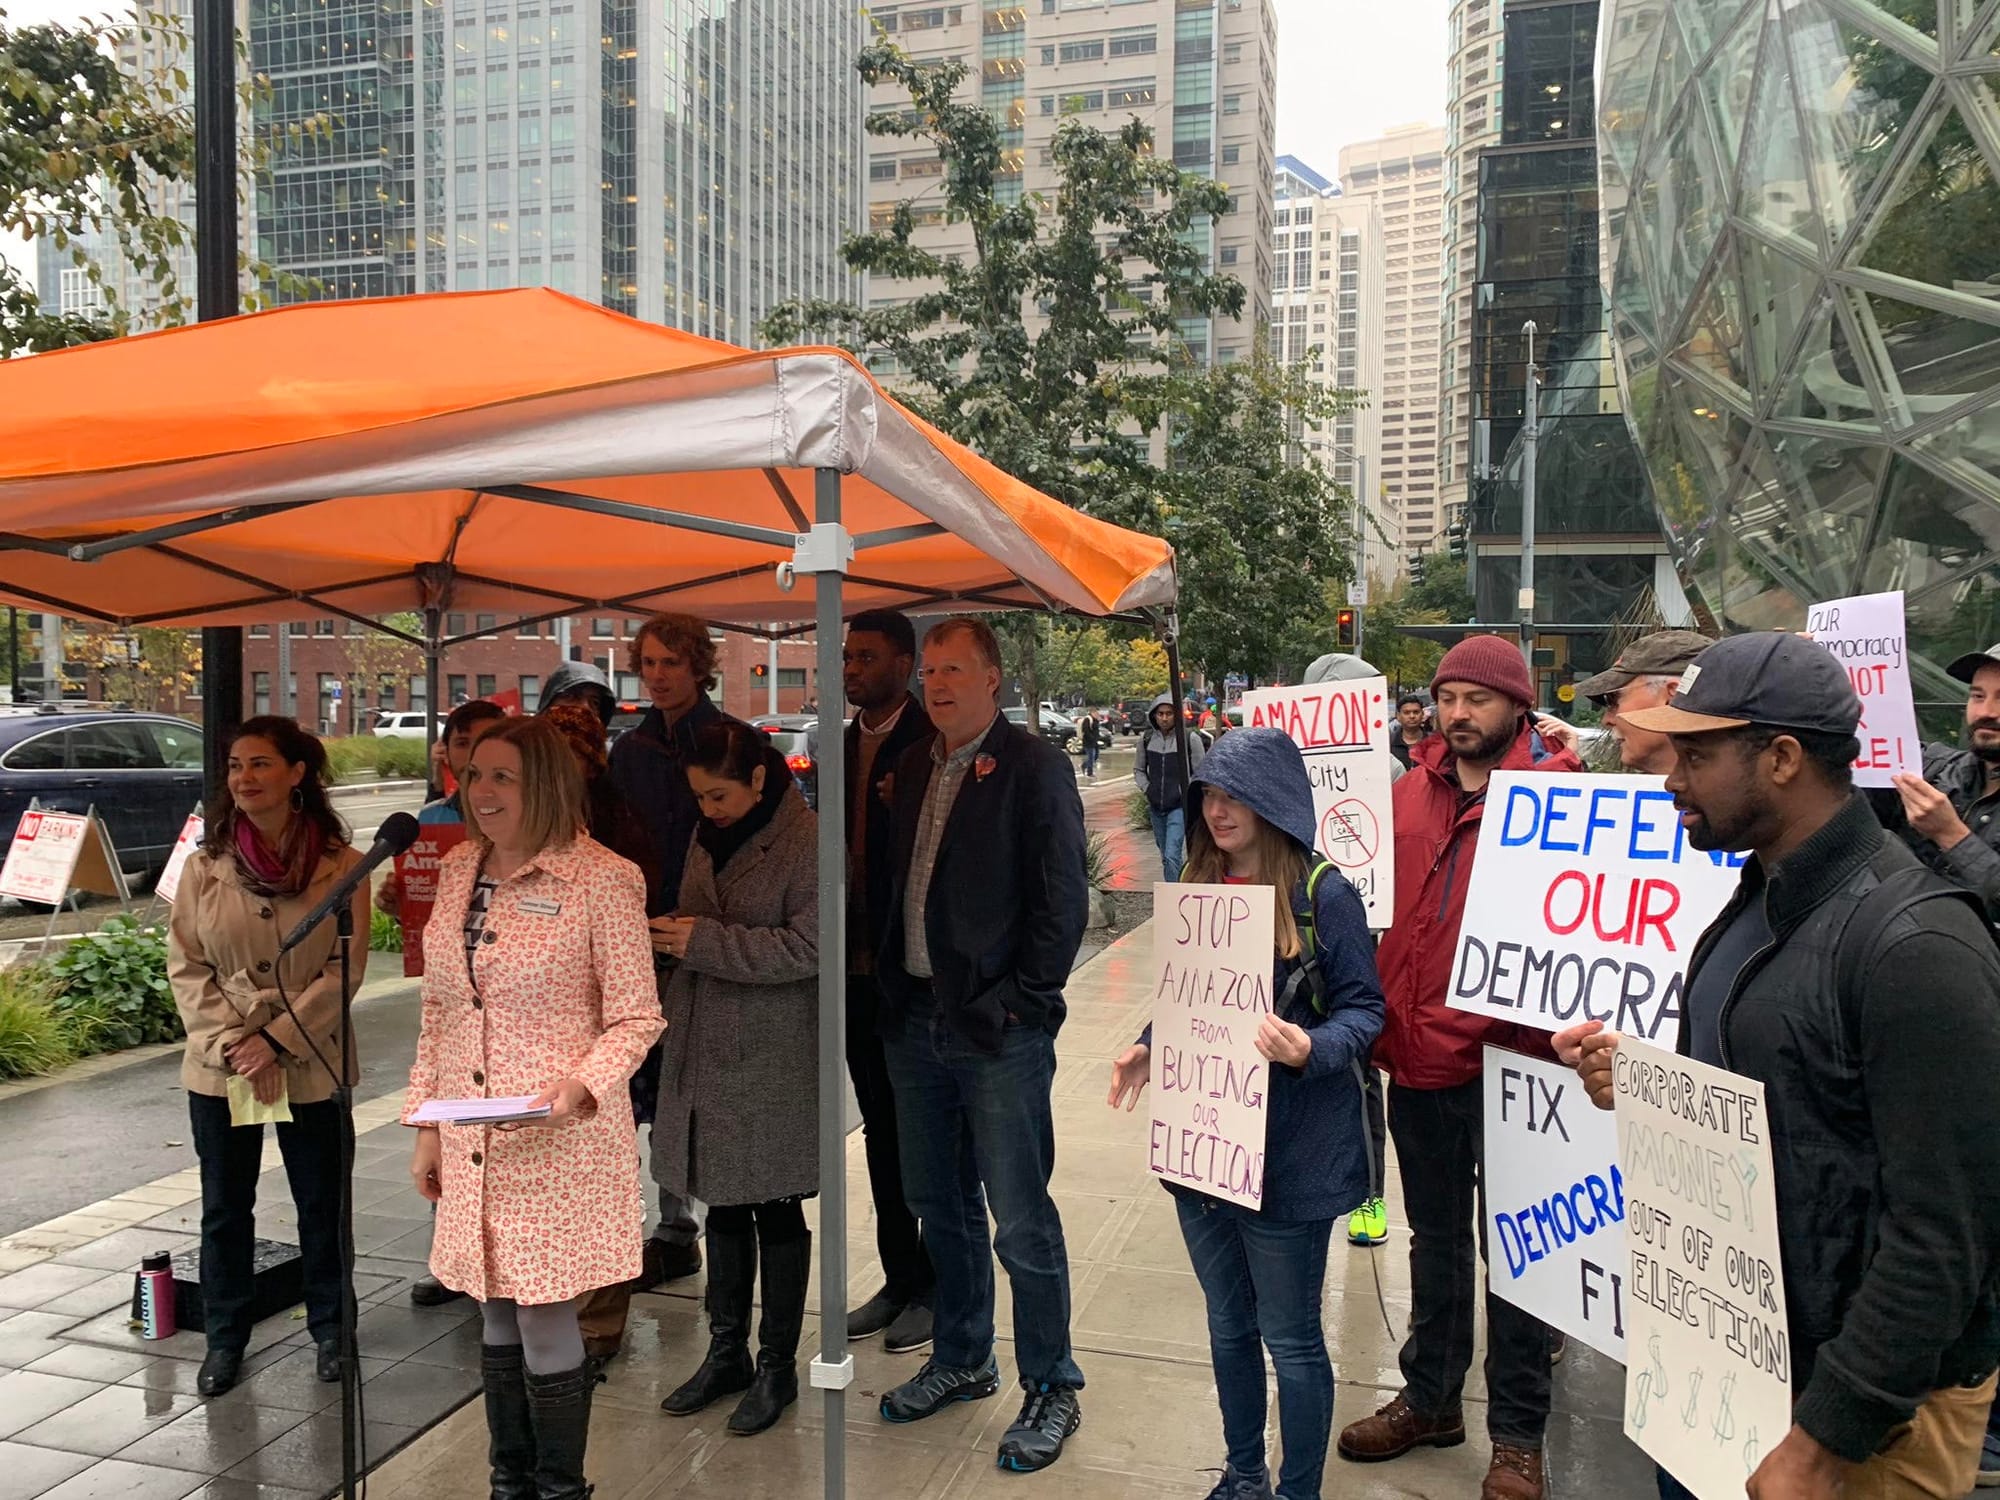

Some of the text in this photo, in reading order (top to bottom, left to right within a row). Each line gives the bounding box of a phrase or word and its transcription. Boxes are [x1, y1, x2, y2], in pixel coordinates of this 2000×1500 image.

[1809, 607, 1840, 633] OUR
[1818, 636, 1902, 668] mocracy
[1252, 689, 1382, 748] AMAZON:
[1850, 737, 1904, 769] LE!
[19, 816, 39, 838] NO
[1500, 785, 1749, 868] DEFE
[402, 854, 441, 870] Am
[1176, 894, 1251, 949] STOP
[1543, 870, 1681, 952] OUR
[1157, 961, 1273, 1014] AMAZON
[1455, 935, 1684, 1039] DEMOCRA
[1190, 1018, 1232, 1045] FROM
[1163, 1046, 1263, 1109] BUYING
[1501, 1067, 1570, 1143] FIX
[1613, 1052, 1759, 1145] CORPORATE
[1192, 1103, 1220, 1134] OUR
[1151, 1119, 1264, 1200] ELECTIONS
[1624, 1120, 1758, 1232] MONEY
[1495, 1164, 1625, 1280] DEMOCRA
[1629, 1199, 1778, 1314] OUT OF OUR
[1581, 1258, 1625, 1340] FI
[1631, 1250, 1788, 1383] ELECTION
